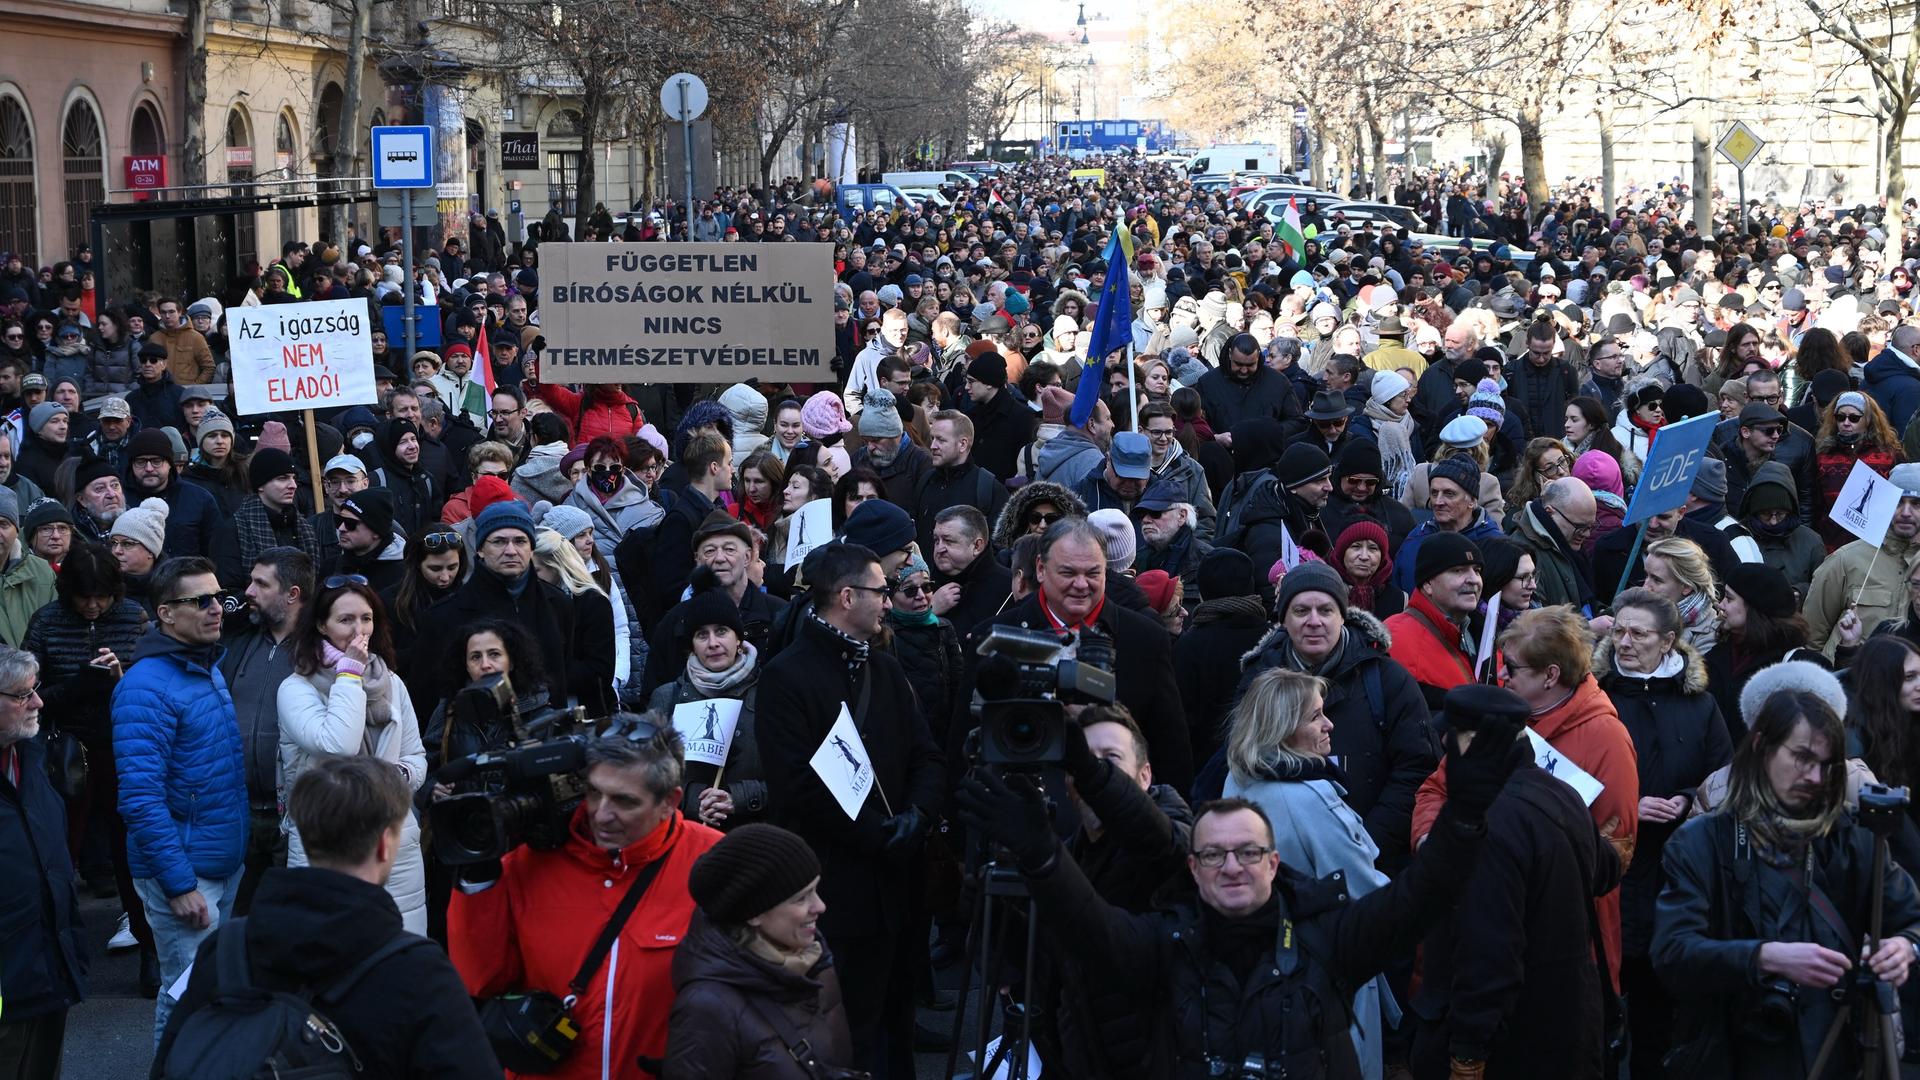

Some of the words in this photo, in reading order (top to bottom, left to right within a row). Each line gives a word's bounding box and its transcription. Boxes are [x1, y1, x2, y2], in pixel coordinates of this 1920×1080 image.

[502, 139, 537, 154] Thai
[130, 159, 159, 171] ATM
[512, 201, 519, 210] P
[606, 250, 757, 272] FÜGGETLEN
[552, 281, 703, 303] BÍRÓSÁGOK
[711, 281, 812, 303] NÉLKÜL
[239, 317, 265, 340] Az
[279, 309, 361, 341] igazság
[643, 317, 722, 335] NINCS
[282, 343, 325, 369] NEM
[546, 343, 820, 366] TERMÉSZETVÉDELEM
[267, 366, 341, 403] ELADÓ!
[1843, 508, 1869, 529] MABIE
[686, 742, 725, 757] MABIE
